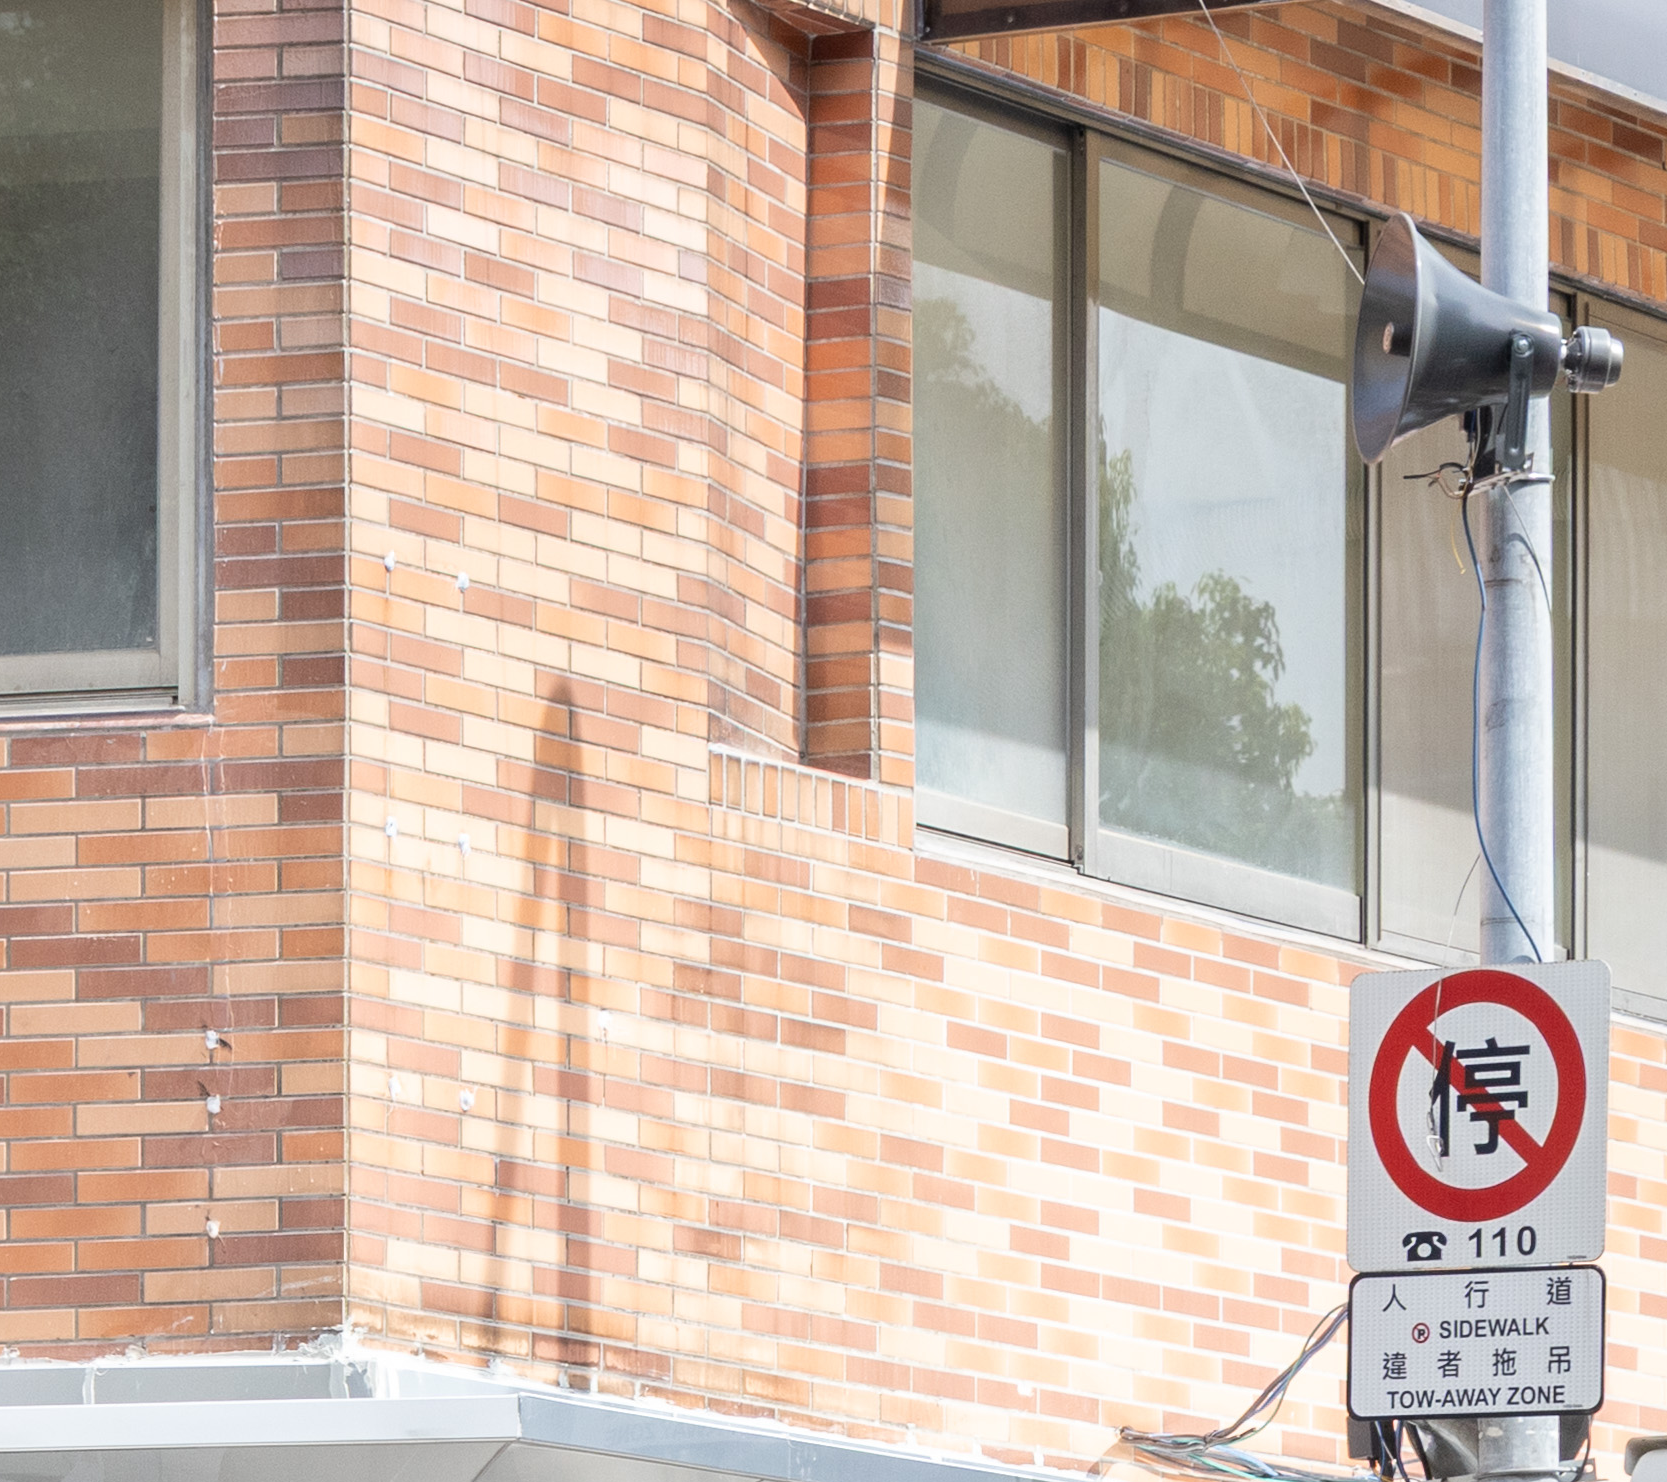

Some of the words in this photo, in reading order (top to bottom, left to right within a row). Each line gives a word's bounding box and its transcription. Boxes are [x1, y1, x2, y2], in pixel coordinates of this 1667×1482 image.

[1429, 1036, 1531, 1158] 停
[1467, 1225, 1537, 1258] 110
[1382, 1276, 1573, 1313] 人行道
[1438, 1316, 1550, 1340] SIDEWALK
[1382, 1345, 1572, 1381] 違者拖吊
[1386, 1387, 1502, 1410] TOW-AWAY
[1506, 1384, 1566, 1406] ZONE
